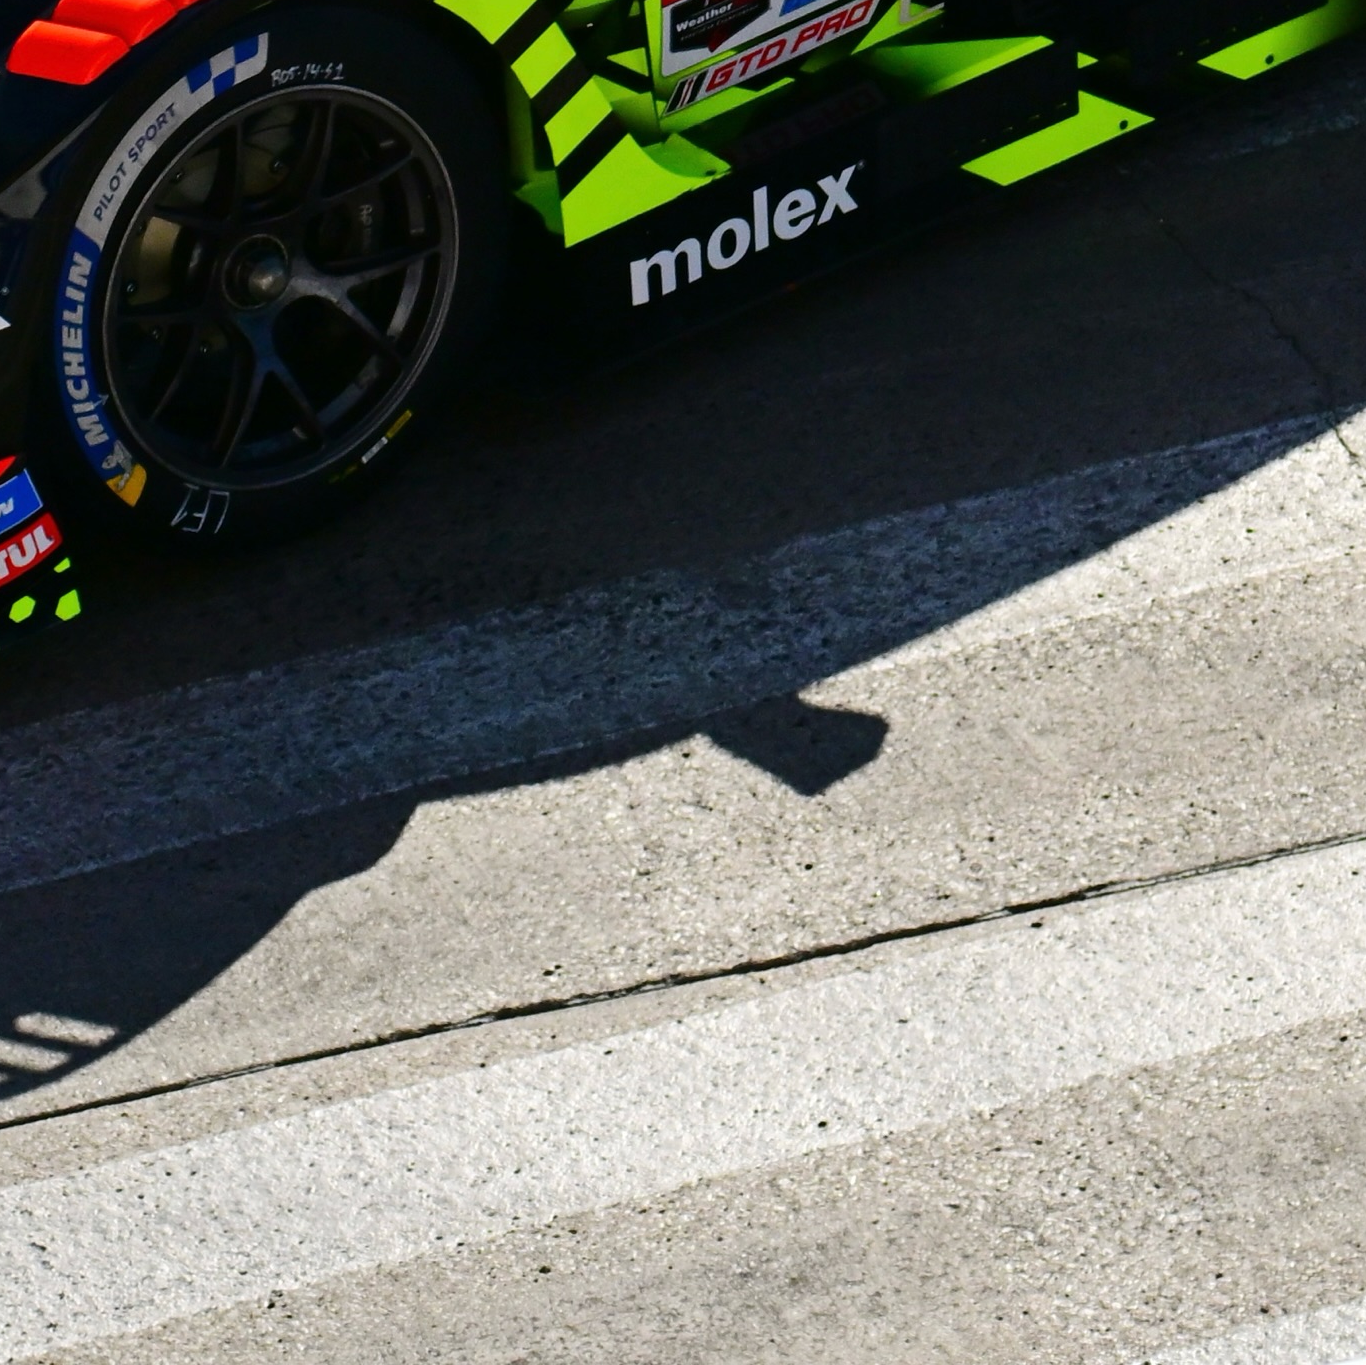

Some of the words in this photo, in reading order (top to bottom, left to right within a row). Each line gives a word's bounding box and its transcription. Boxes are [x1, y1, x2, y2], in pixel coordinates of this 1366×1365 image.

[705, 39, 787, 93] GTD
[93, 169, 127, 221] PILOT
[128, 101, 177, 164] SPORT
[630, 162, 859, 306] molex
[62, 251, 110, 447] MICHELIN
